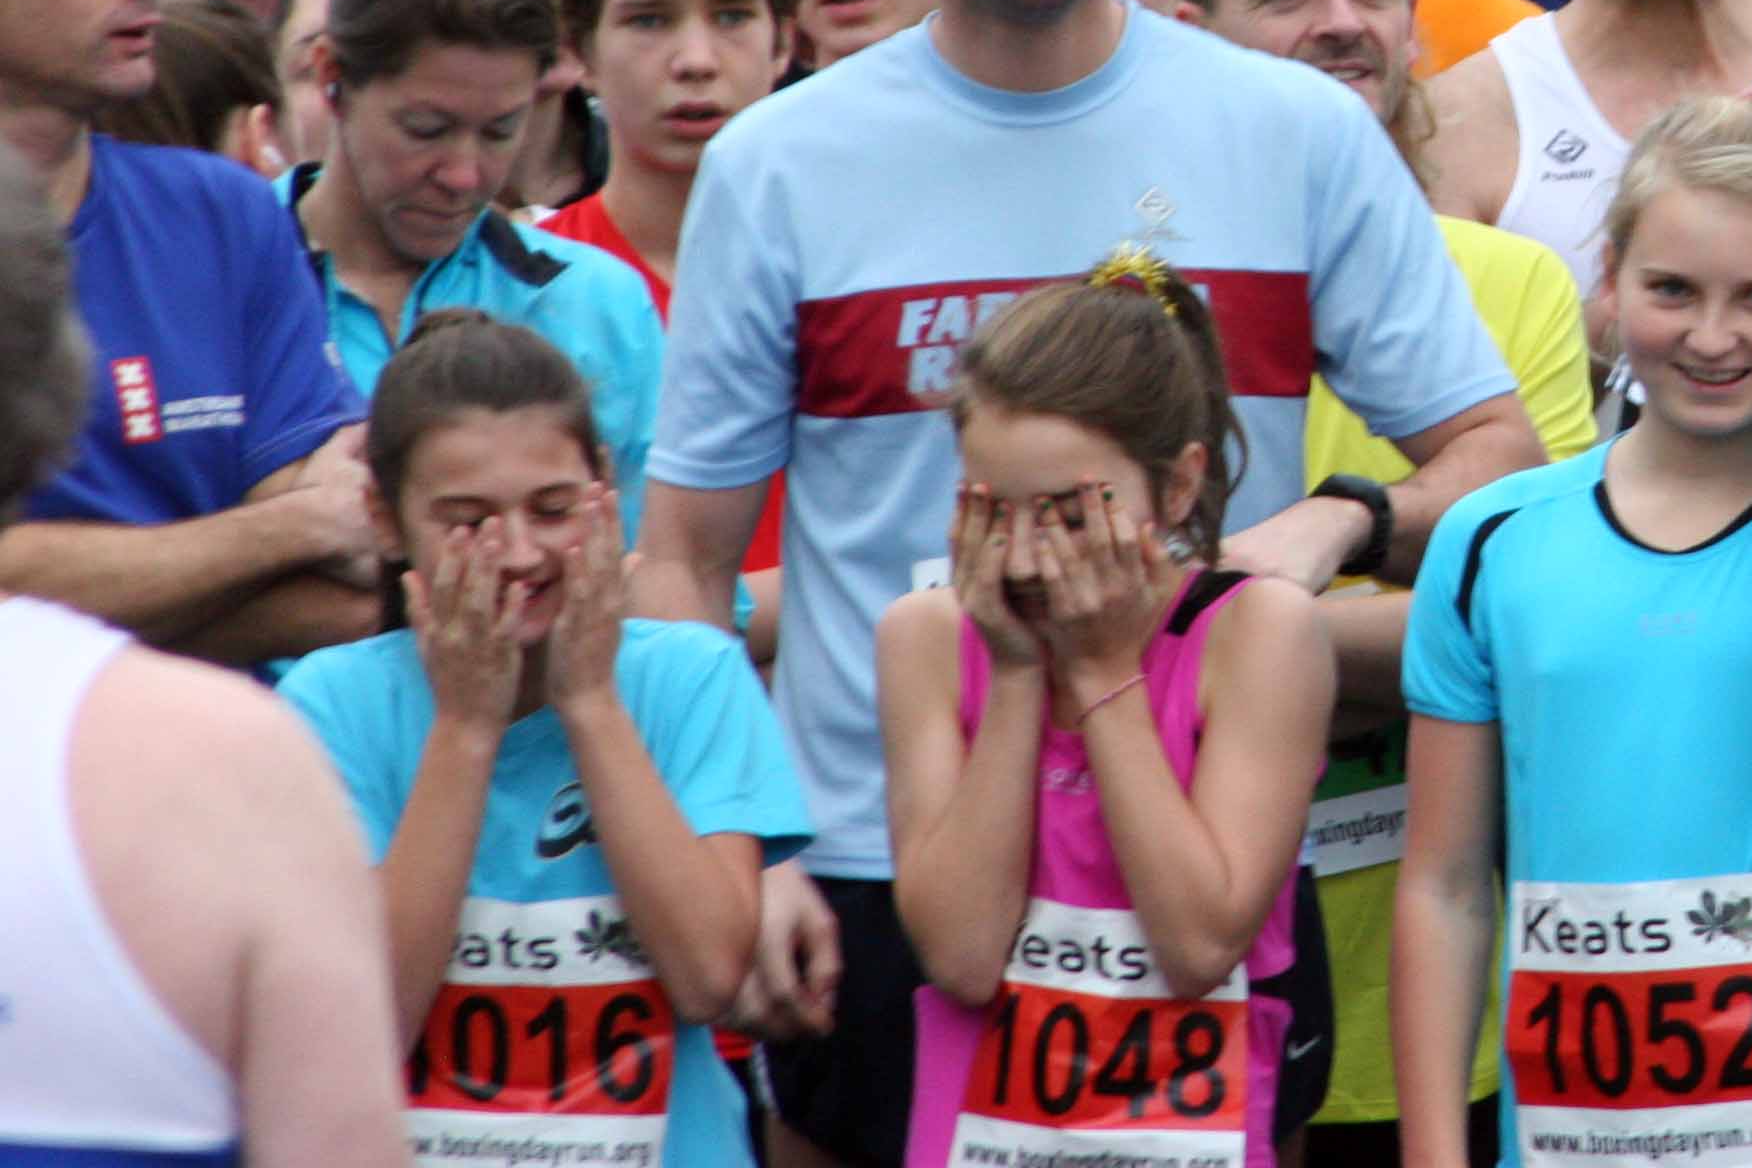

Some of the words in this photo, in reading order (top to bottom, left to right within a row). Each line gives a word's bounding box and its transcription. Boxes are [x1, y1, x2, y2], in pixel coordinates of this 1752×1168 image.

[458, 927, 560, 970] ats
[1521, 897, 1673, 956] Keats
[1014, 928, 1150, 982] eats
[990, 992, 1227, 1119] 1048
